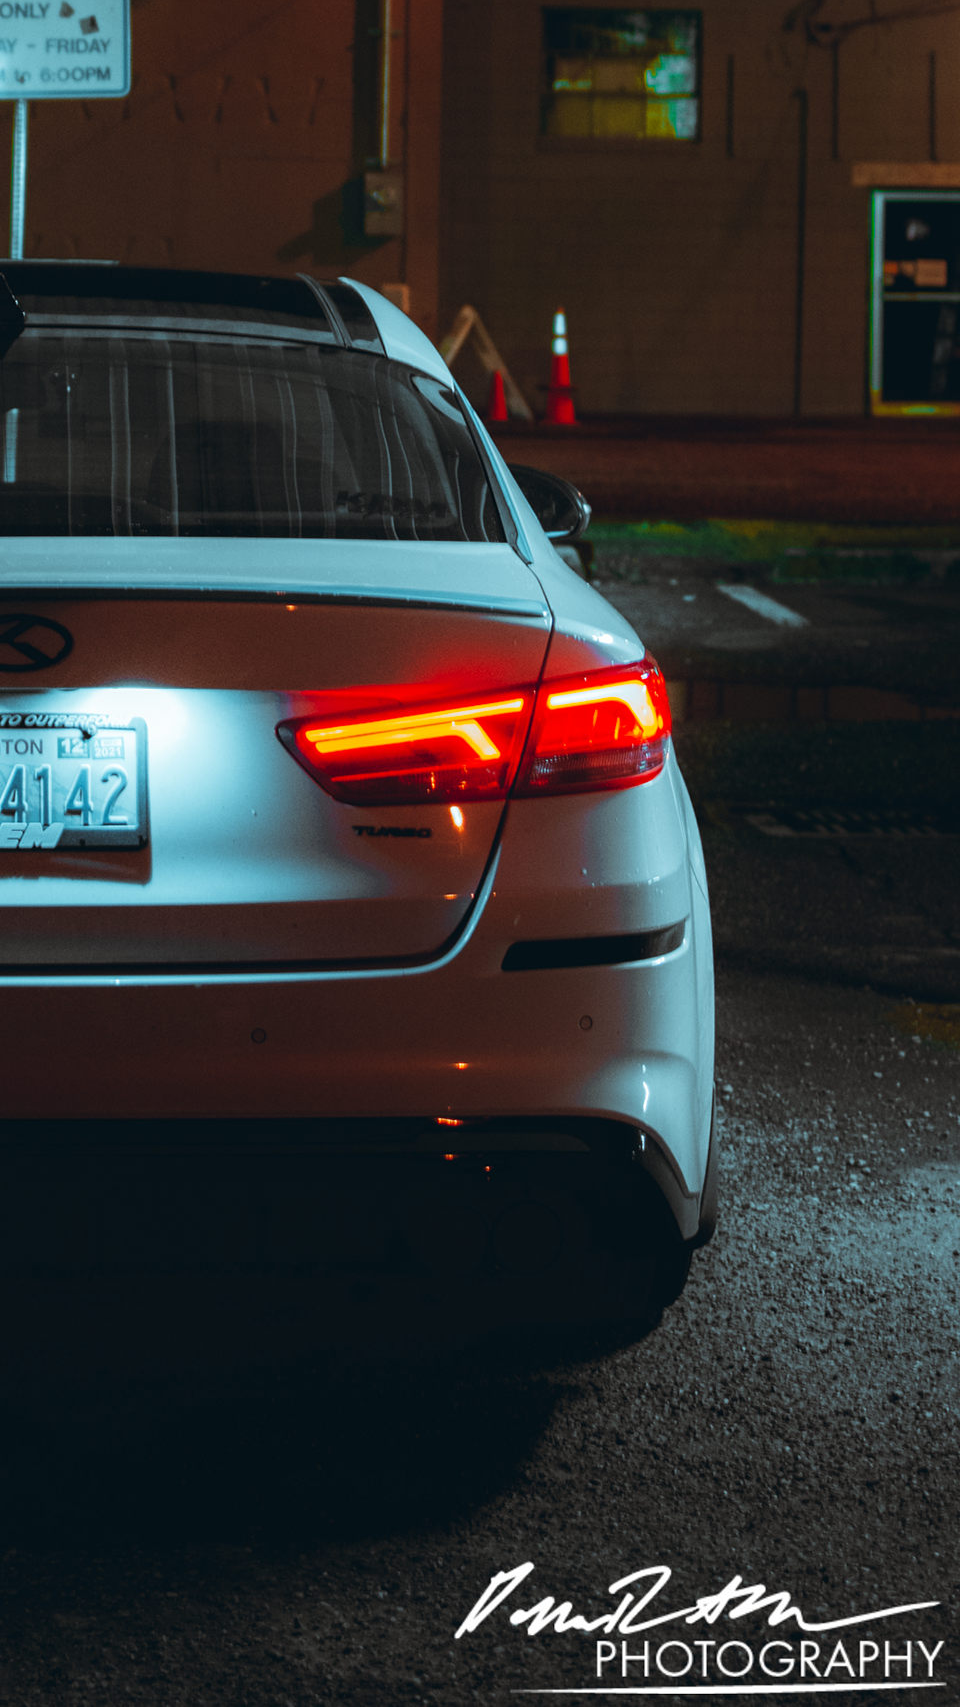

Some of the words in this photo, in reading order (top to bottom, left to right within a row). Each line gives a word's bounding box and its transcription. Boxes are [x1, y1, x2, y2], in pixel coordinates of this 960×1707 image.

[44, 36, 112, 55] FRIDAY
[39, 65, 112, 83] 6:00PM
[23, 714, 132, 728] OUTPERFORM
[94, 746, 122, 758] 2021
